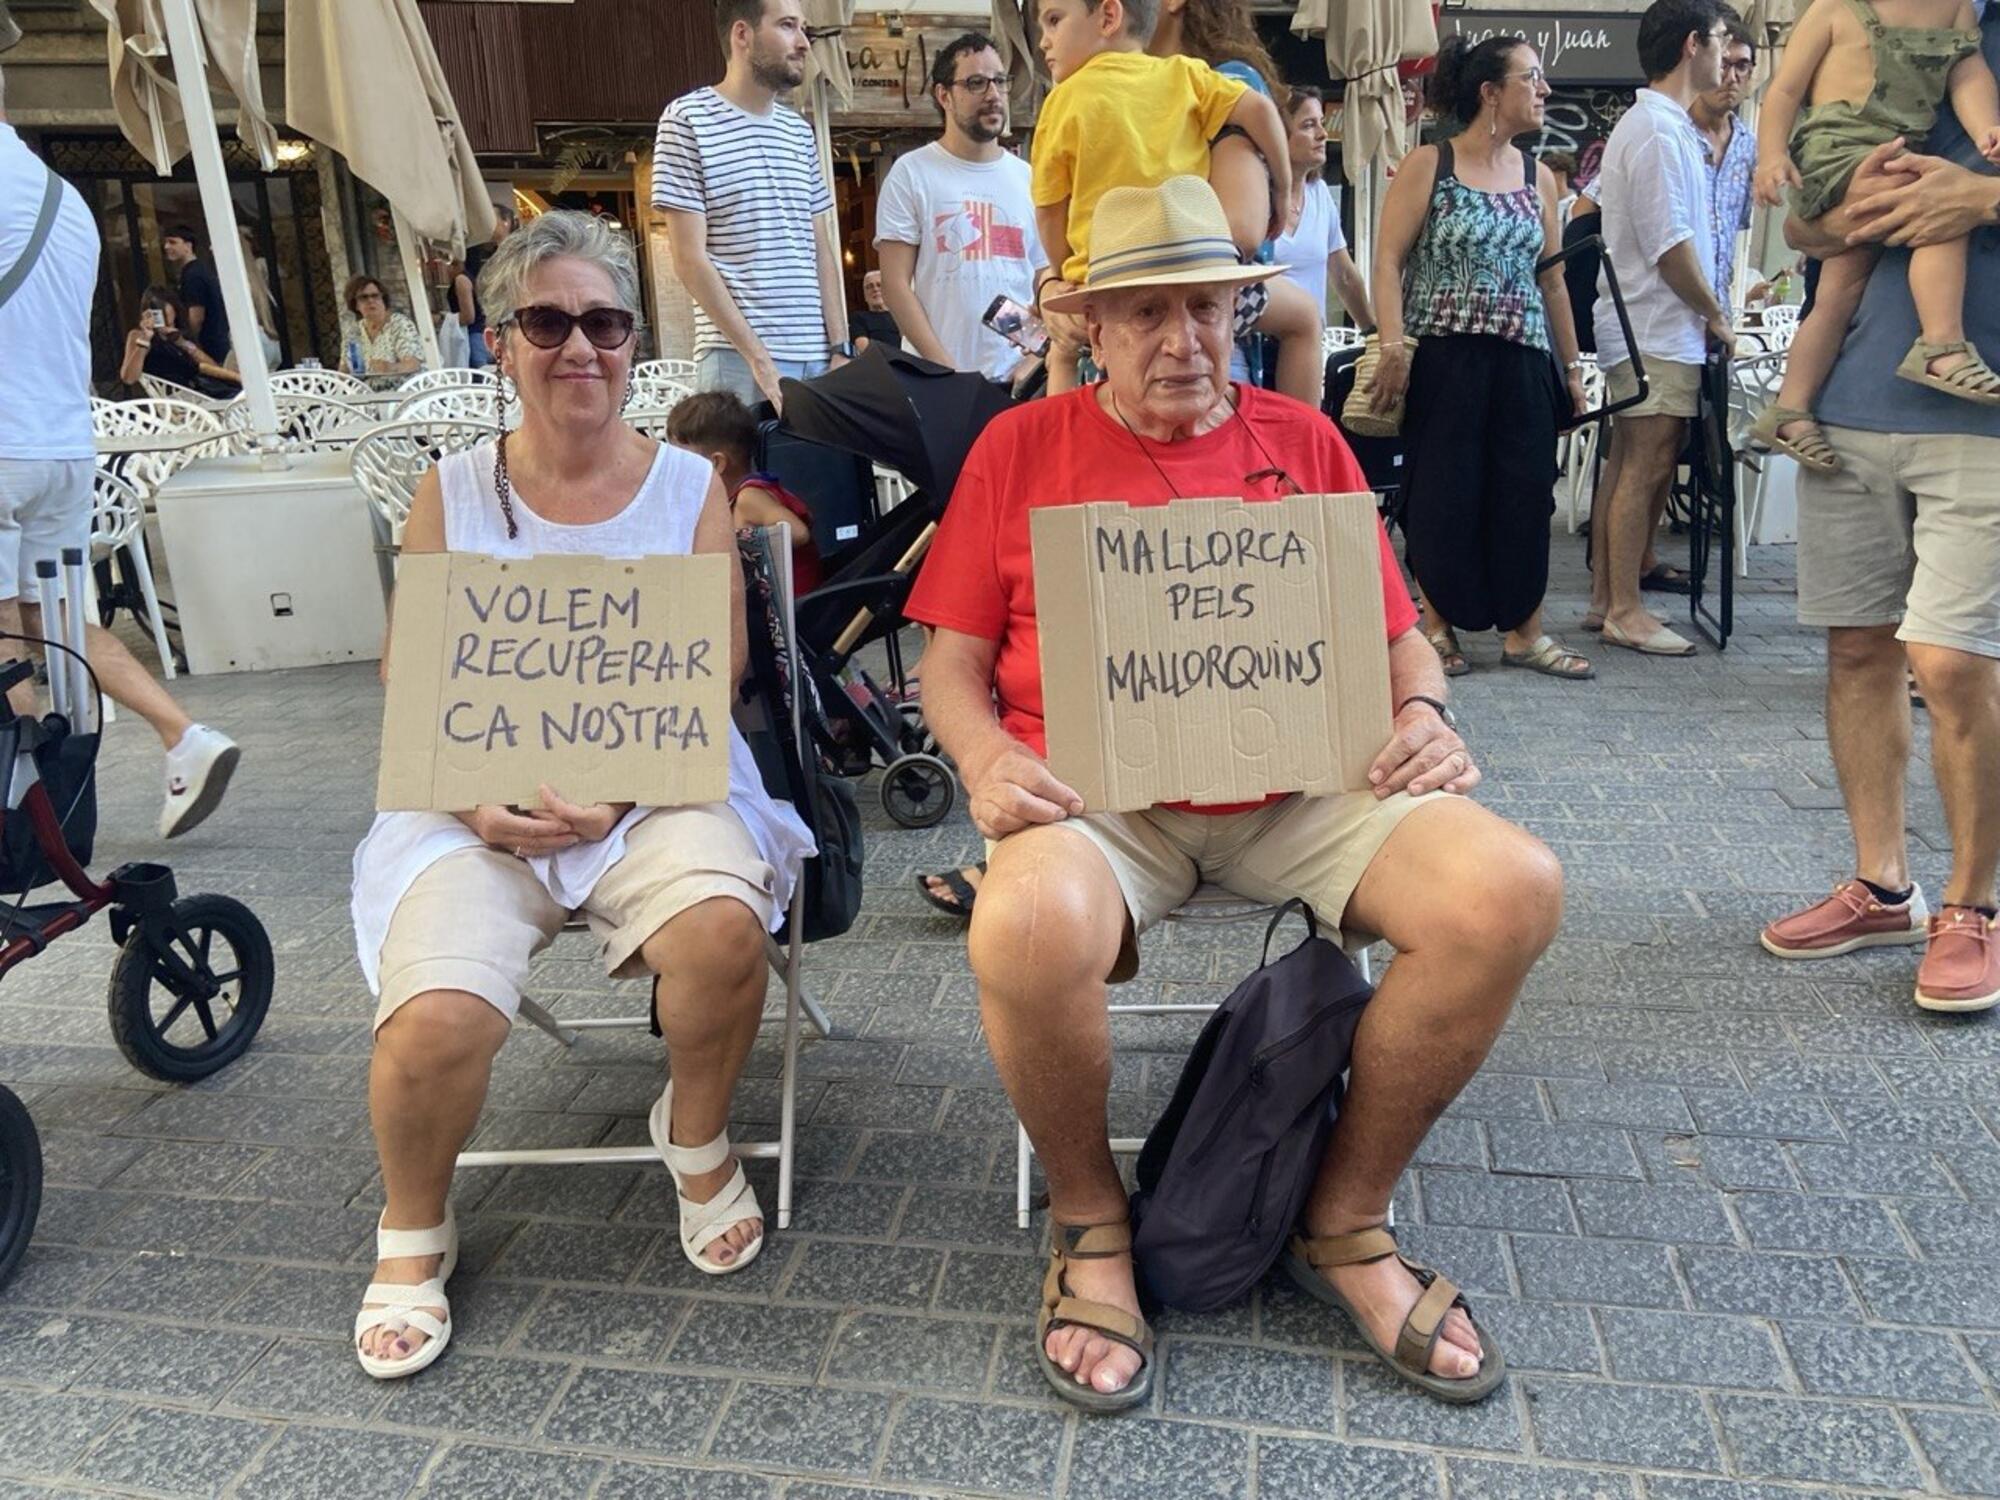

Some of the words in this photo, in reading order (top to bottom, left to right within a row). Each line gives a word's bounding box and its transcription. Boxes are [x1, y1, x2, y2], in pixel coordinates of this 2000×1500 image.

[1537, 30, 1550, 71] y
[1551, 19, 1612, 67] Juan
[1096, 526, 1307, 575] MALLORCA
[464, 584, 641, 632] VOLEM
[1165, 582, 1256, 621] PELS
[451, 632, 713, 687] RECUPERAR
[443, 701, 520, 752] CA
[541, 701, 709, 751] NOSTRA
